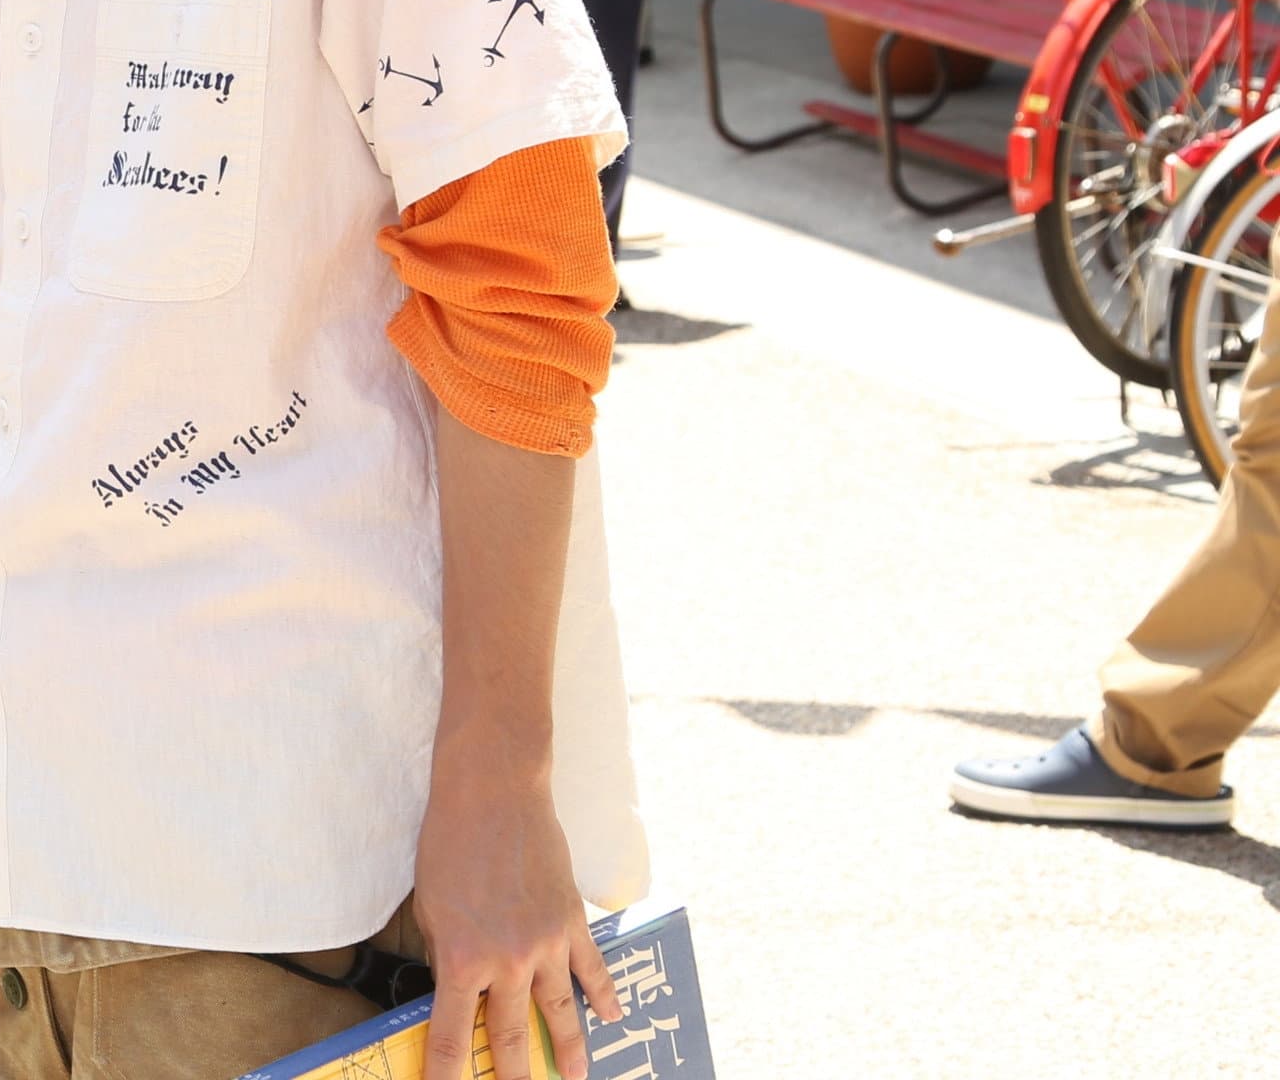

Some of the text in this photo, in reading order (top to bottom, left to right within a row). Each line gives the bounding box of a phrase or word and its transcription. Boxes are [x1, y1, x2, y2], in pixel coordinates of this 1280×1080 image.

[91, 420, 200, 508] Always
[144, 390, 308, 527] In My Heart
